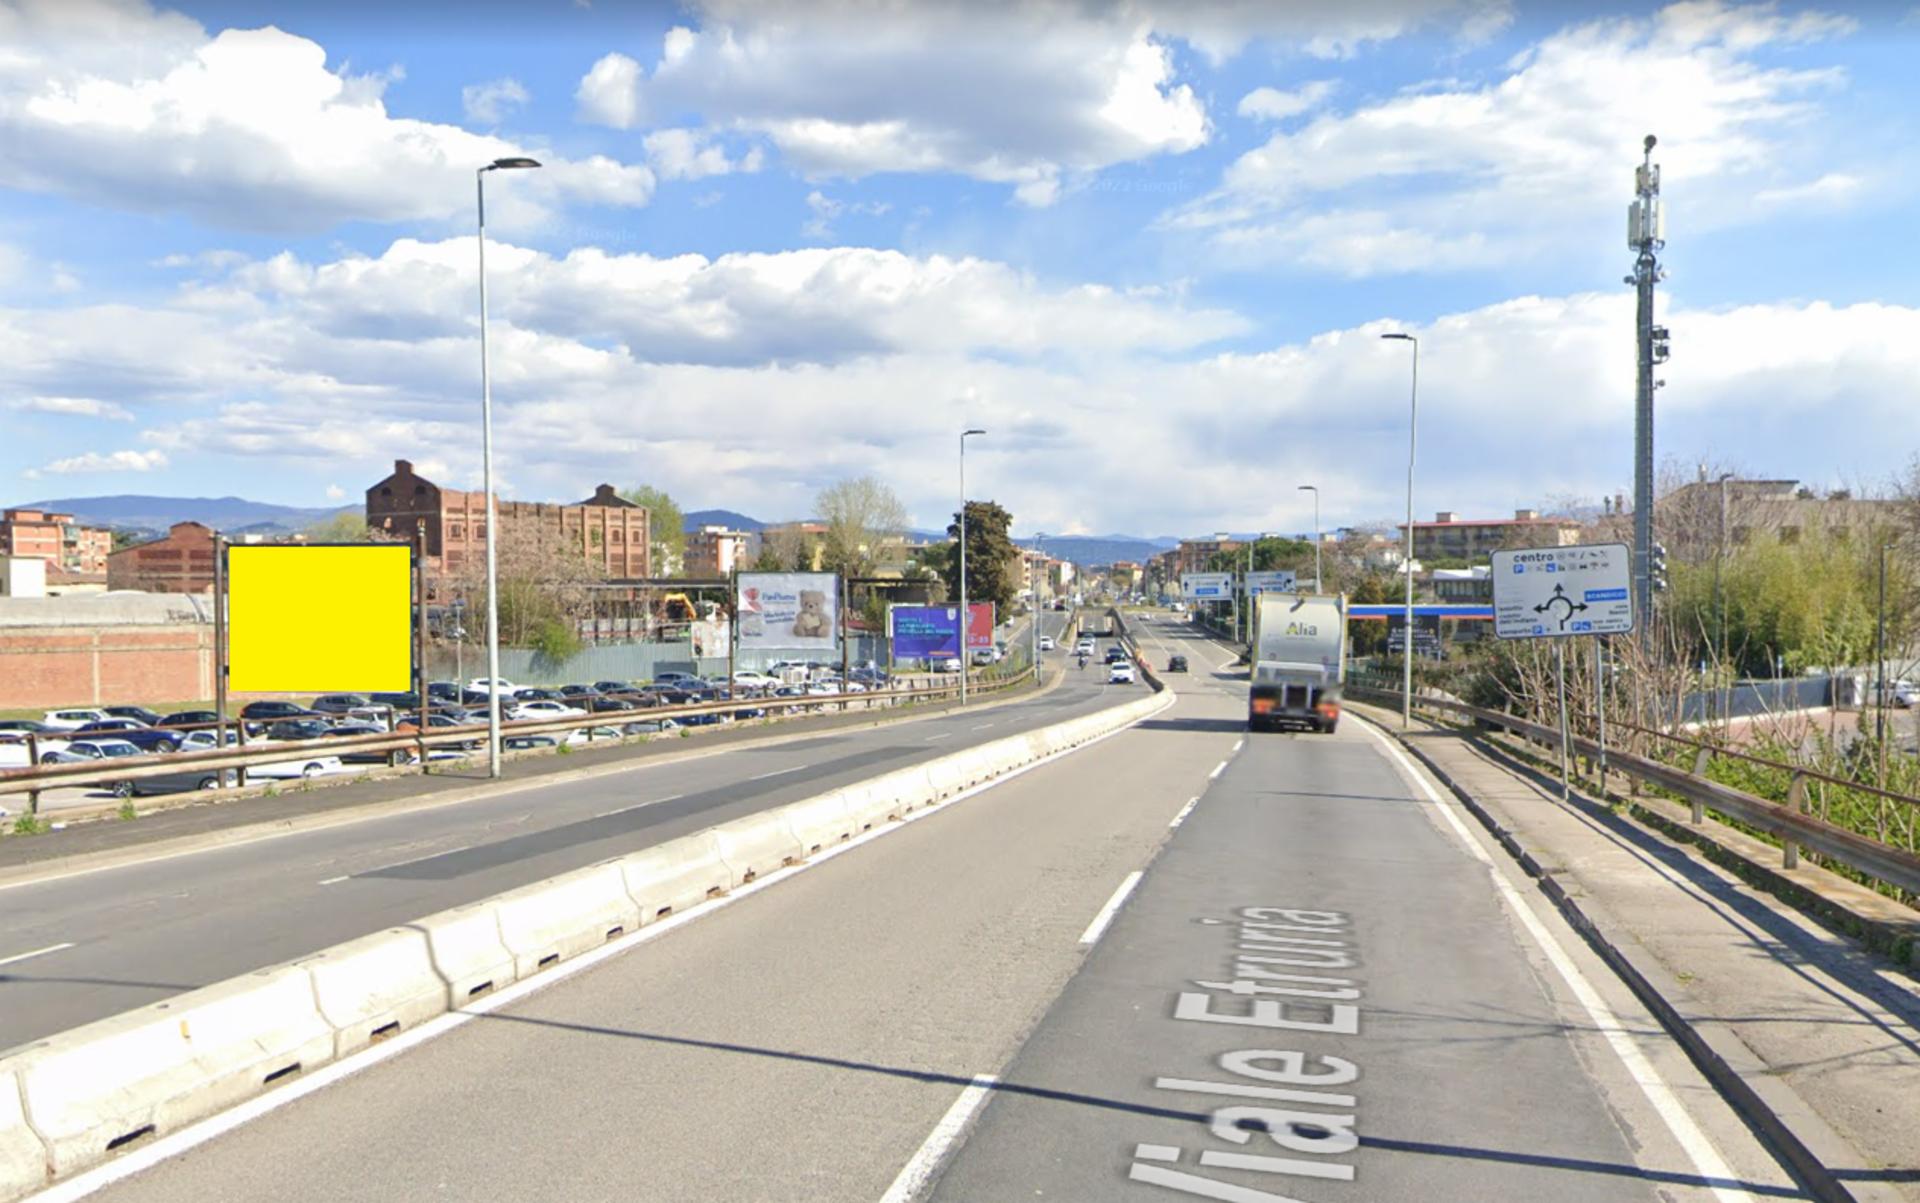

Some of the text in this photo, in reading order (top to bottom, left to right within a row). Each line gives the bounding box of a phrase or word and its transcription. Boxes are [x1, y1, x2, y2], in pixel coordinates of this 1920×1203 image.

[1513, 552, 1554, 563] centro
[1286, 621, 1317, 636] Alia
[1174, 906, 1361, 1035] Etruria
